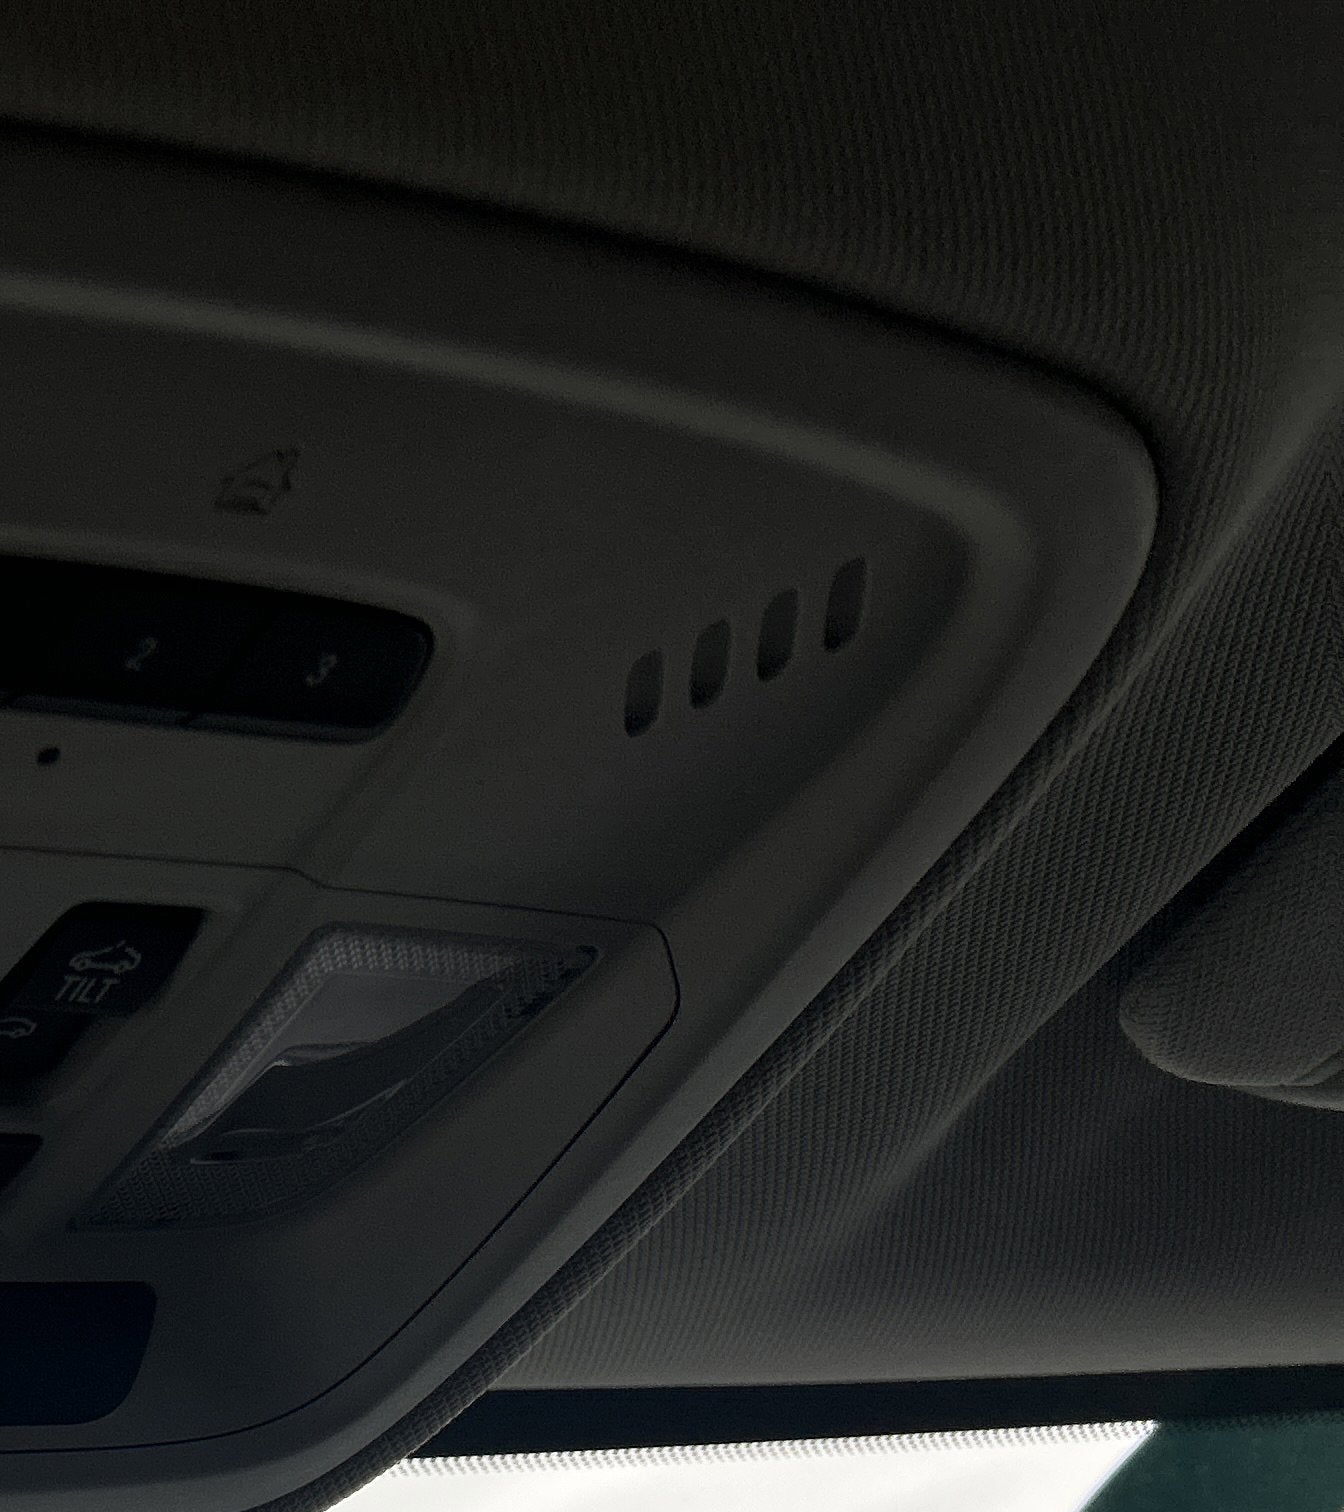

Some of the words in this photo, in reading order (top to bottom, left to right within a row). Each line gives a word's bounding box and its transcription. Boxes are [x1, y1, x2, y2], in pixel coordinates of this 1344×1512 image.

[125, 637, 158, 672] 2
[305, 653, 338, 687] 3
[54, 974, 121, 1004] TILT
